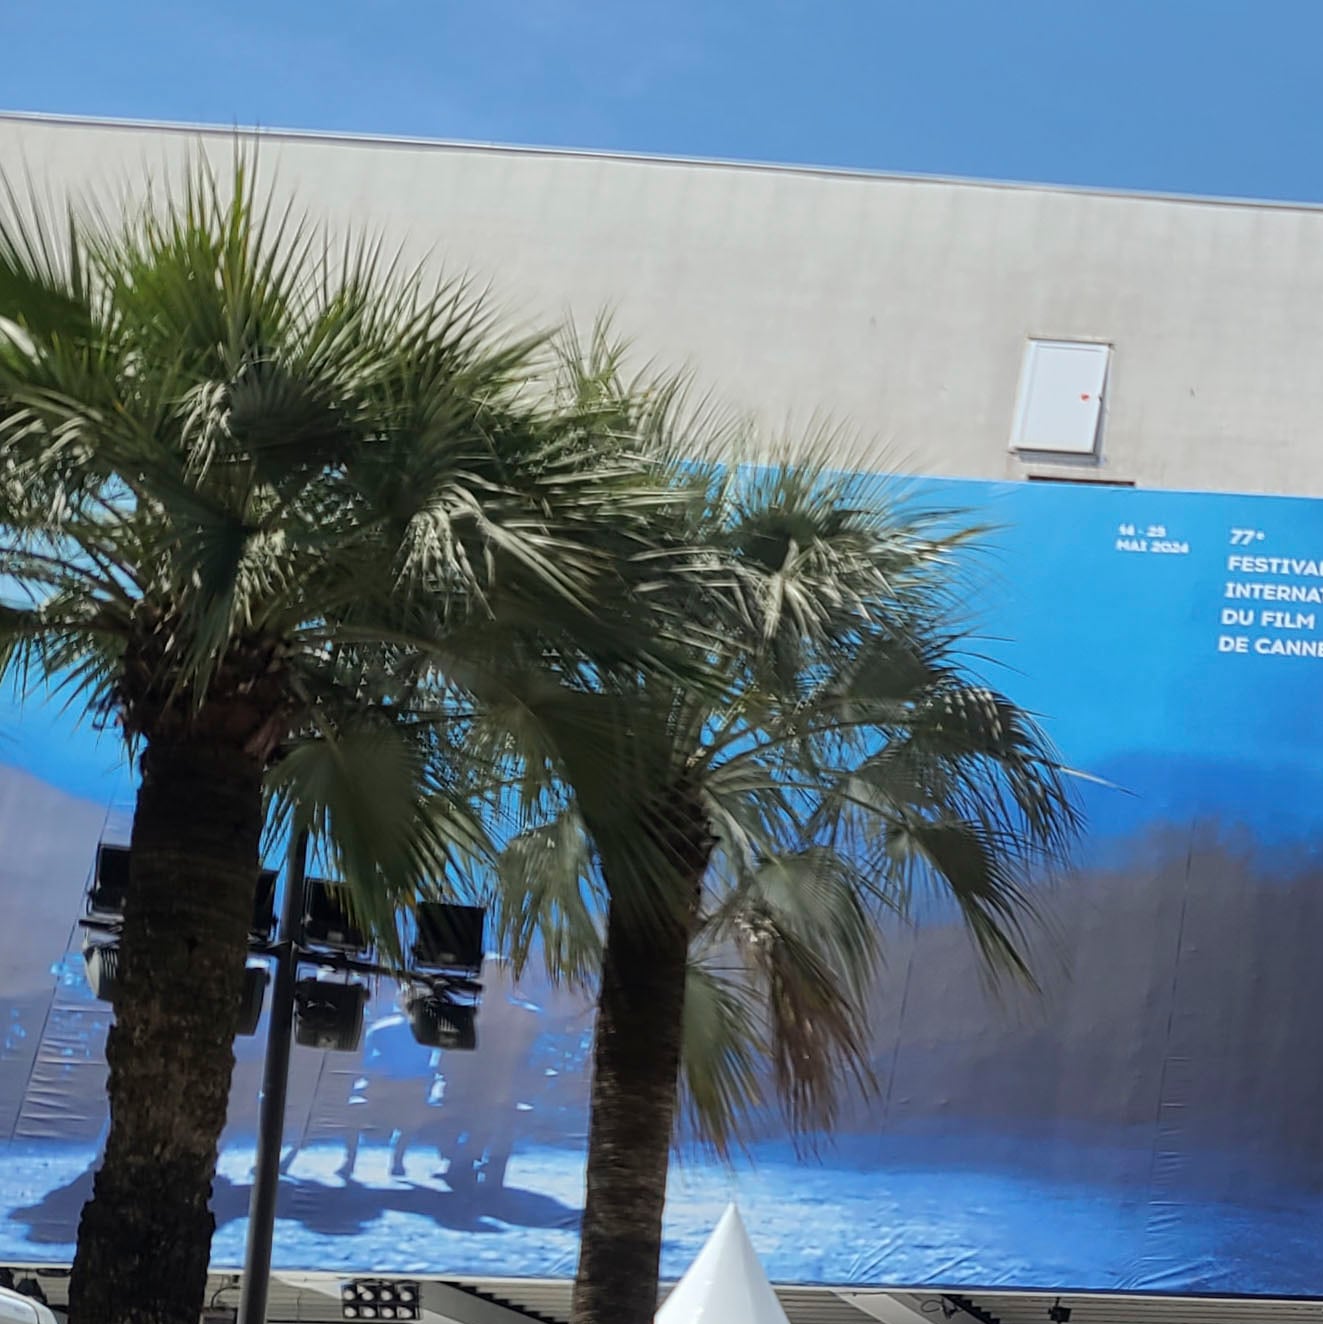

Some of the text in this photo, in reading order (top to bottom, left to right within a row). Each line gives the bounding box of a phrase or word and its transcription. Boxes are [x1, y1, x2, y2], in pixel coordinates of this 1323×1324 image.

[1115, 538, 1190, 554] MAI 2024
[1221, 608, 1315, 630] DU FILM
[1218, 635, 1250, 654] DE
